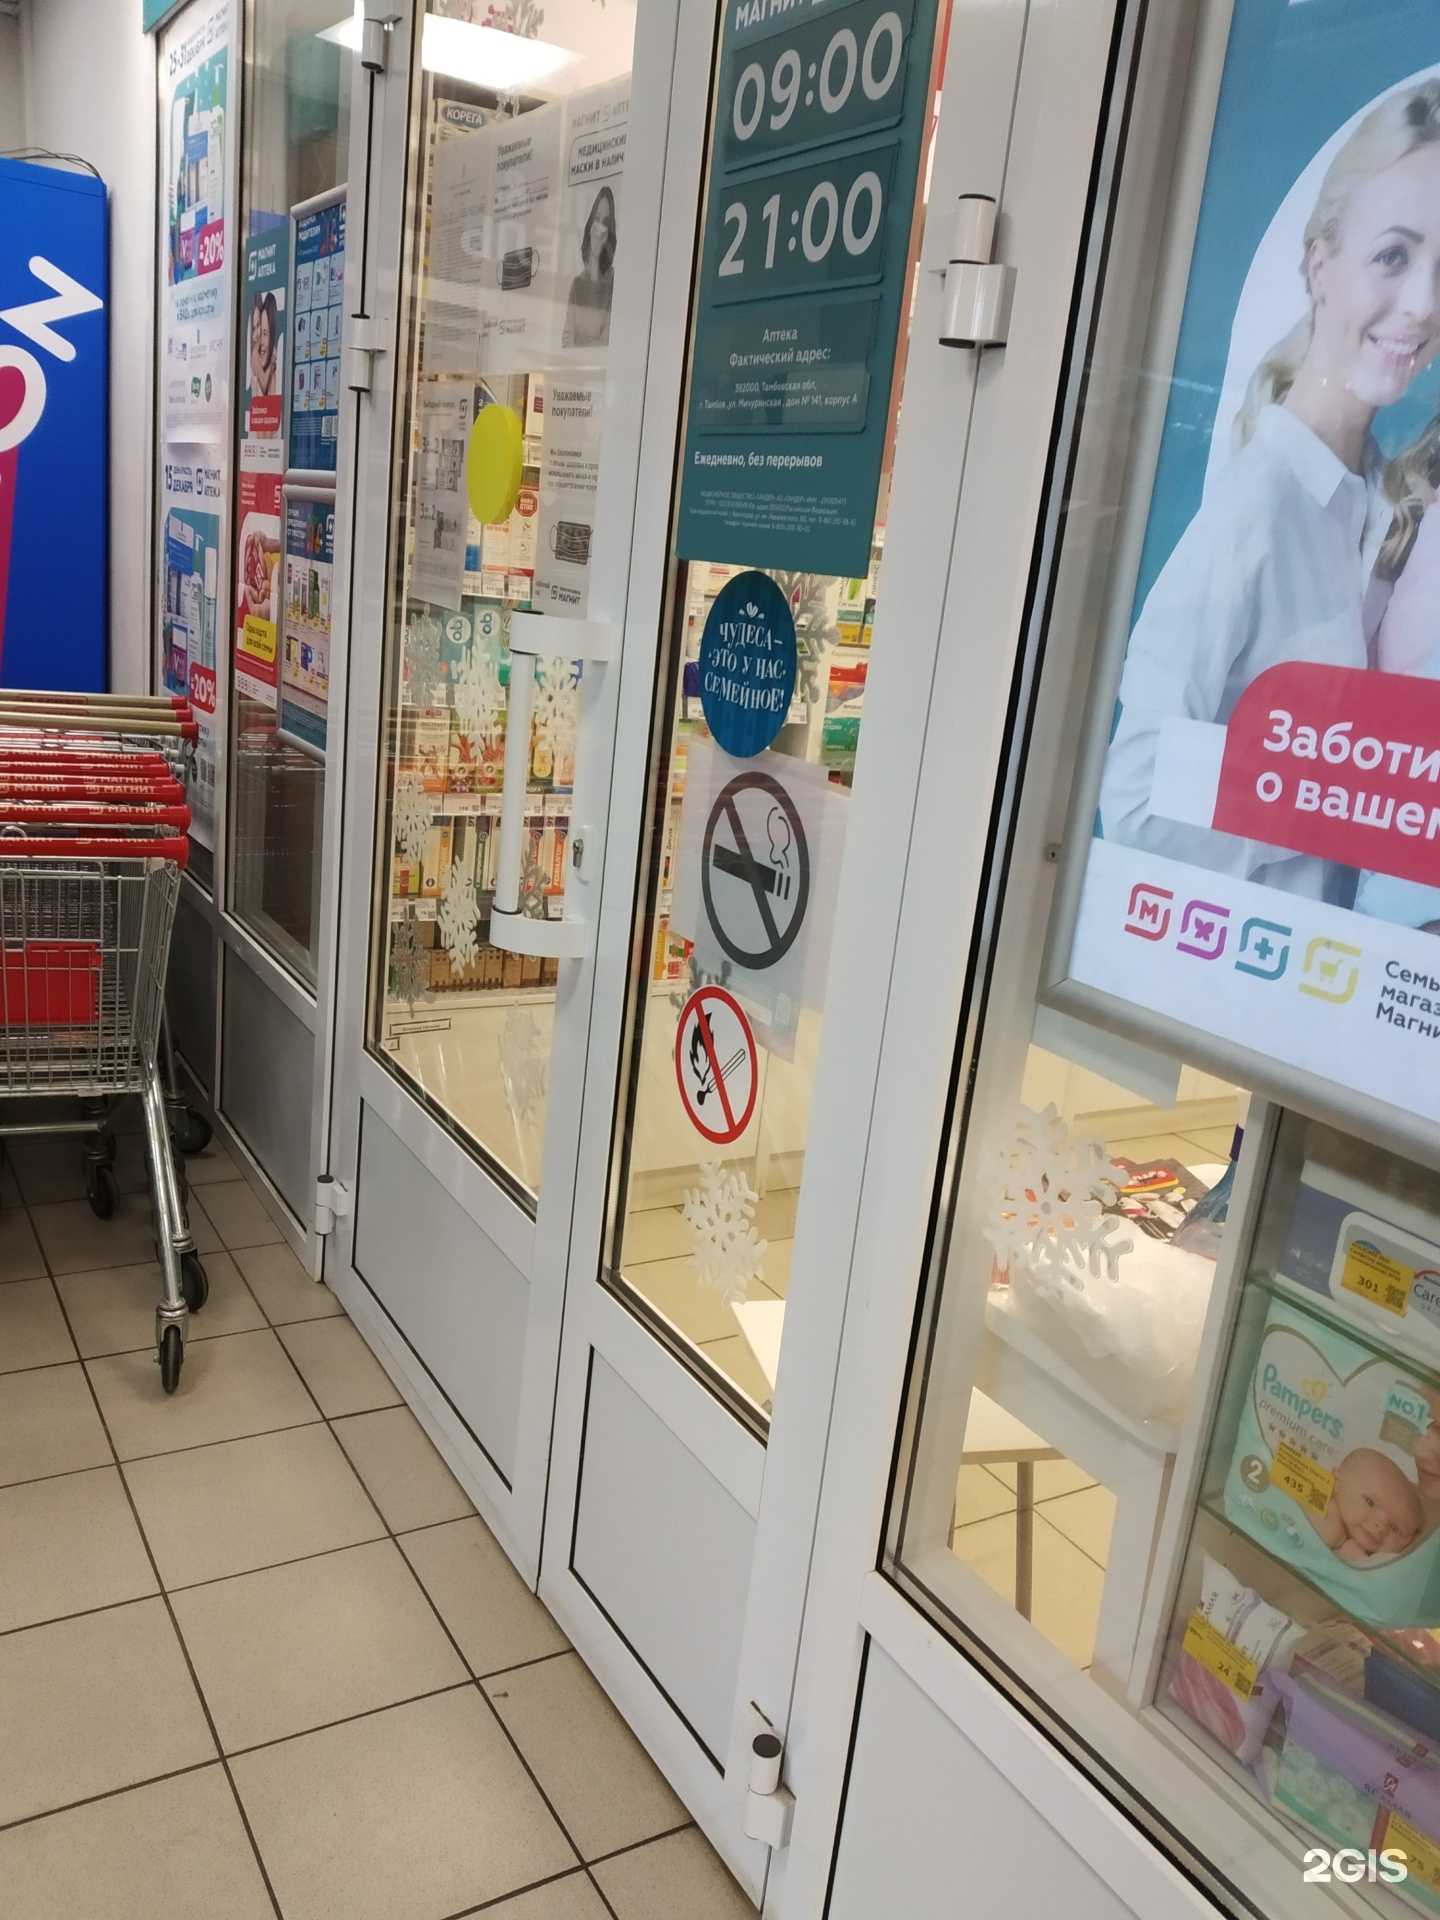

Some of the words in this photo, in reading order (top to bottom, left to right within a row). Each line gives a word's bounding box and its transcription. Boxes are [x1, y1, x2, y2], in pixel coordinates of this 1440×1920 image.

[733, 11, 903, 141] 09:00
[446, 106, 484, 125] КОРЕГА
[718, 171, 883, 278] 21:00
[762, 328, 798, 344] Аптека
[729, 348, 794, 368] Фактический
[796, 347, 831, 364] адрес:
[694, 451, 746, 467] Ежедневно,
[748, 451, 764, 466] без
[766, 454, 823, 469] перерывов
[711, 648, 738, 672] ЭТО
[742, 656, 753, 675] У
[755, 657, 786, 680] НАС
[704, 671, 785, 713] СЕМЕЙНОЕ!
[1255, 771, 1283, 803] о
[1357, 1275, 1379, 1293] 301
[1263, 1363, 1344, 1440] Pampers
[1258, 1399, 1308, 1438] premium
[1247, 1459, 1261, 1484] 2
[1283, 1475, 1304, 1494] 435
